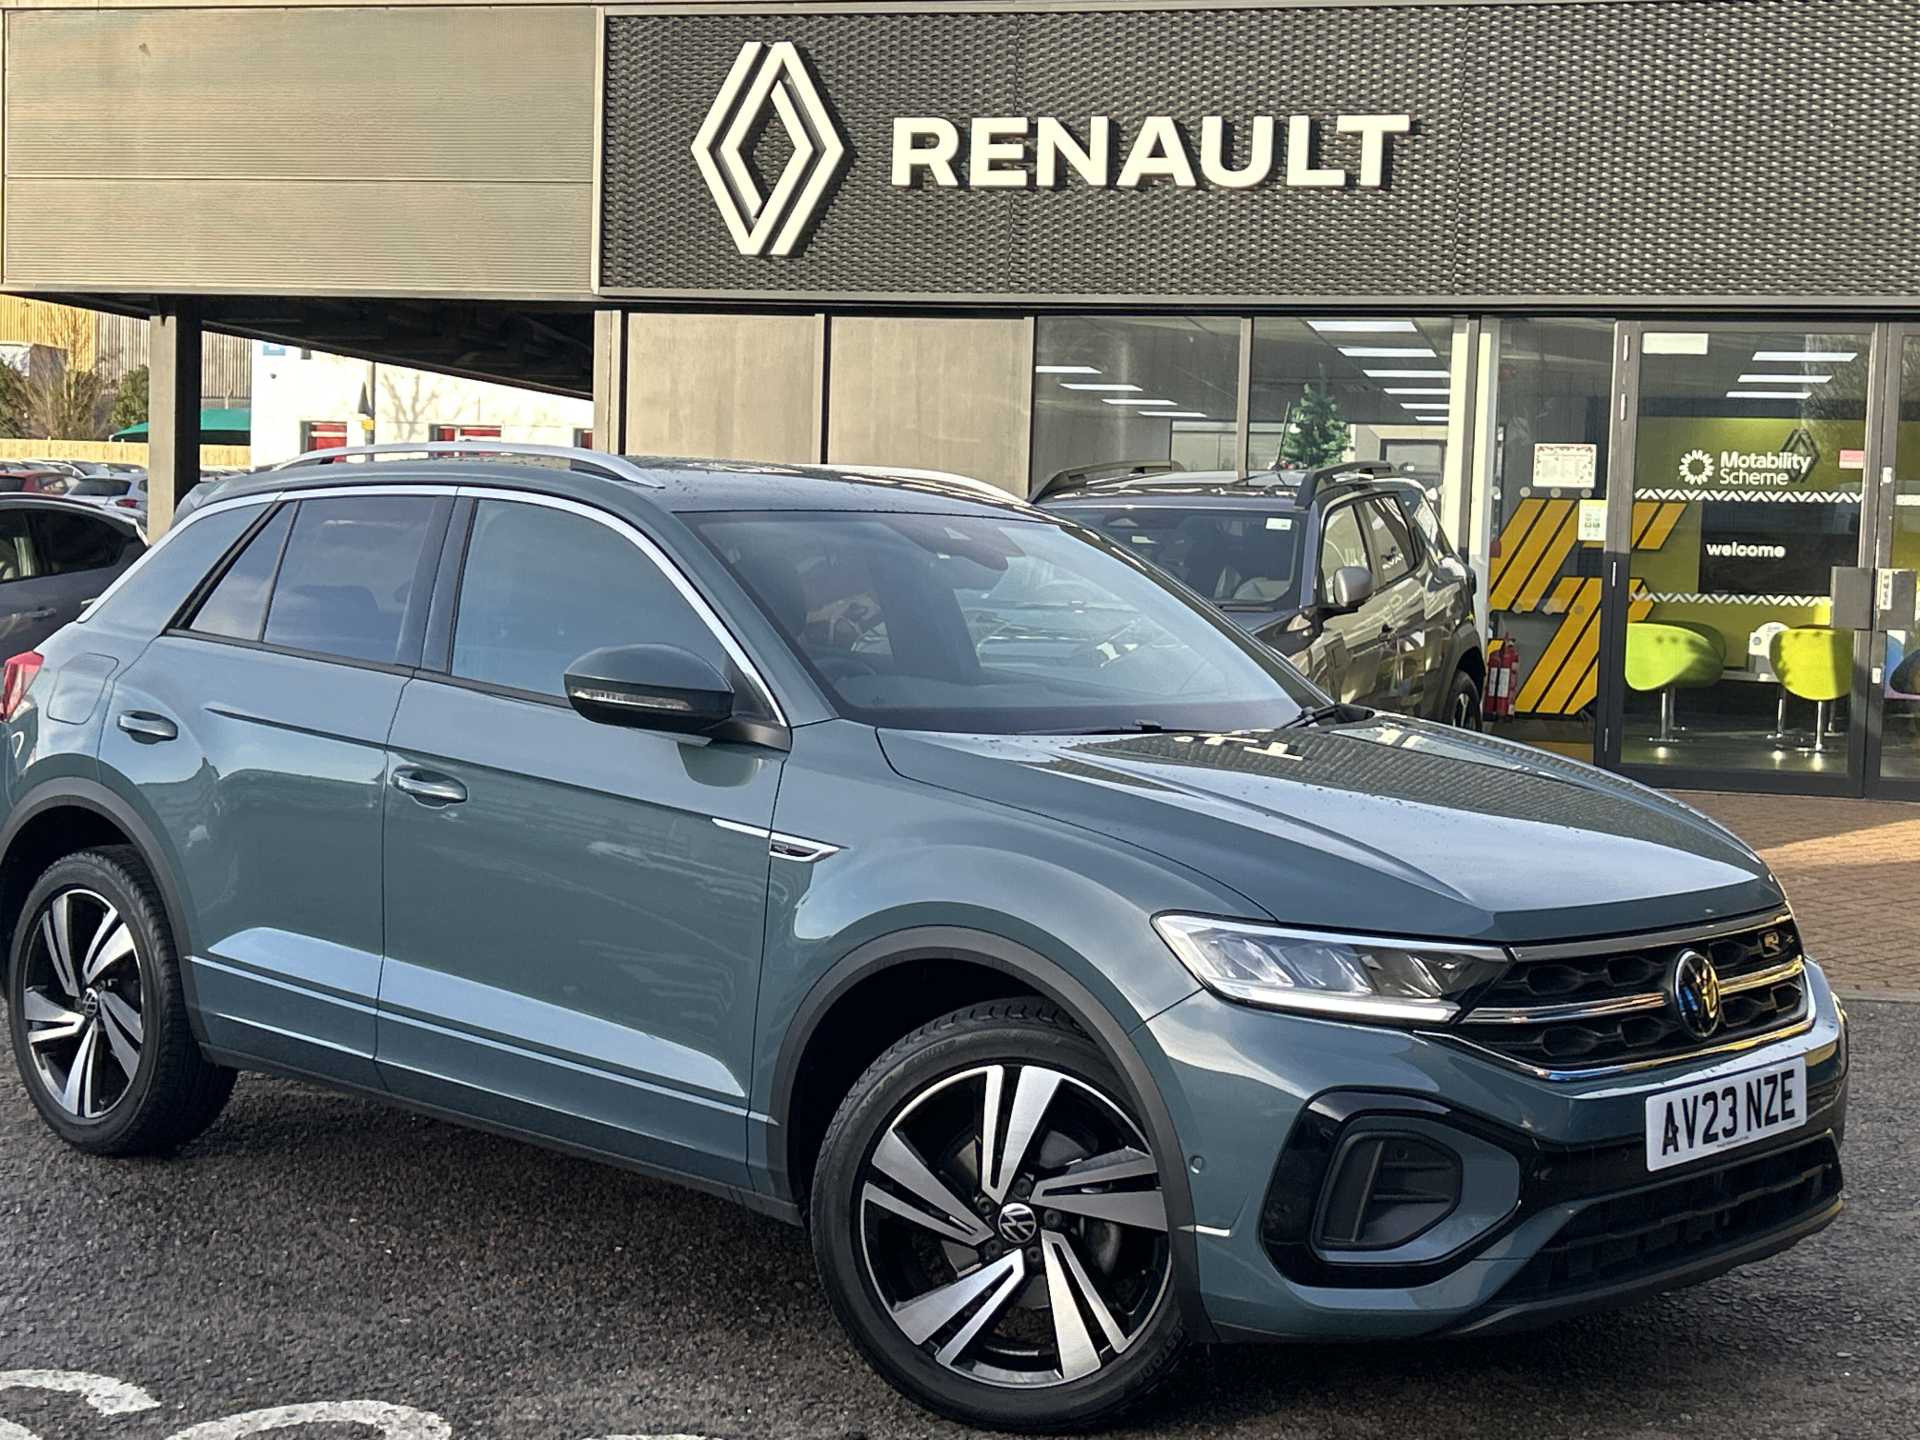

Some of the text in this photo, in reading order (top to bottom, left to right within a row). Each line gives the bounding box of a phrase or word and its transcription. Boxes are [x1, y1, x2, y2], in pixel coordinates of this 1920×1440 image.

[891, 114, 1411, 189] RENAULT
[1720, 451, 1812, 473] Motability
[1719, 468, 1789, 486] Scheme
[1706, 541, 1786, 558] welcome
[1661, 1068, 1796, 1156] AV23 NZE
